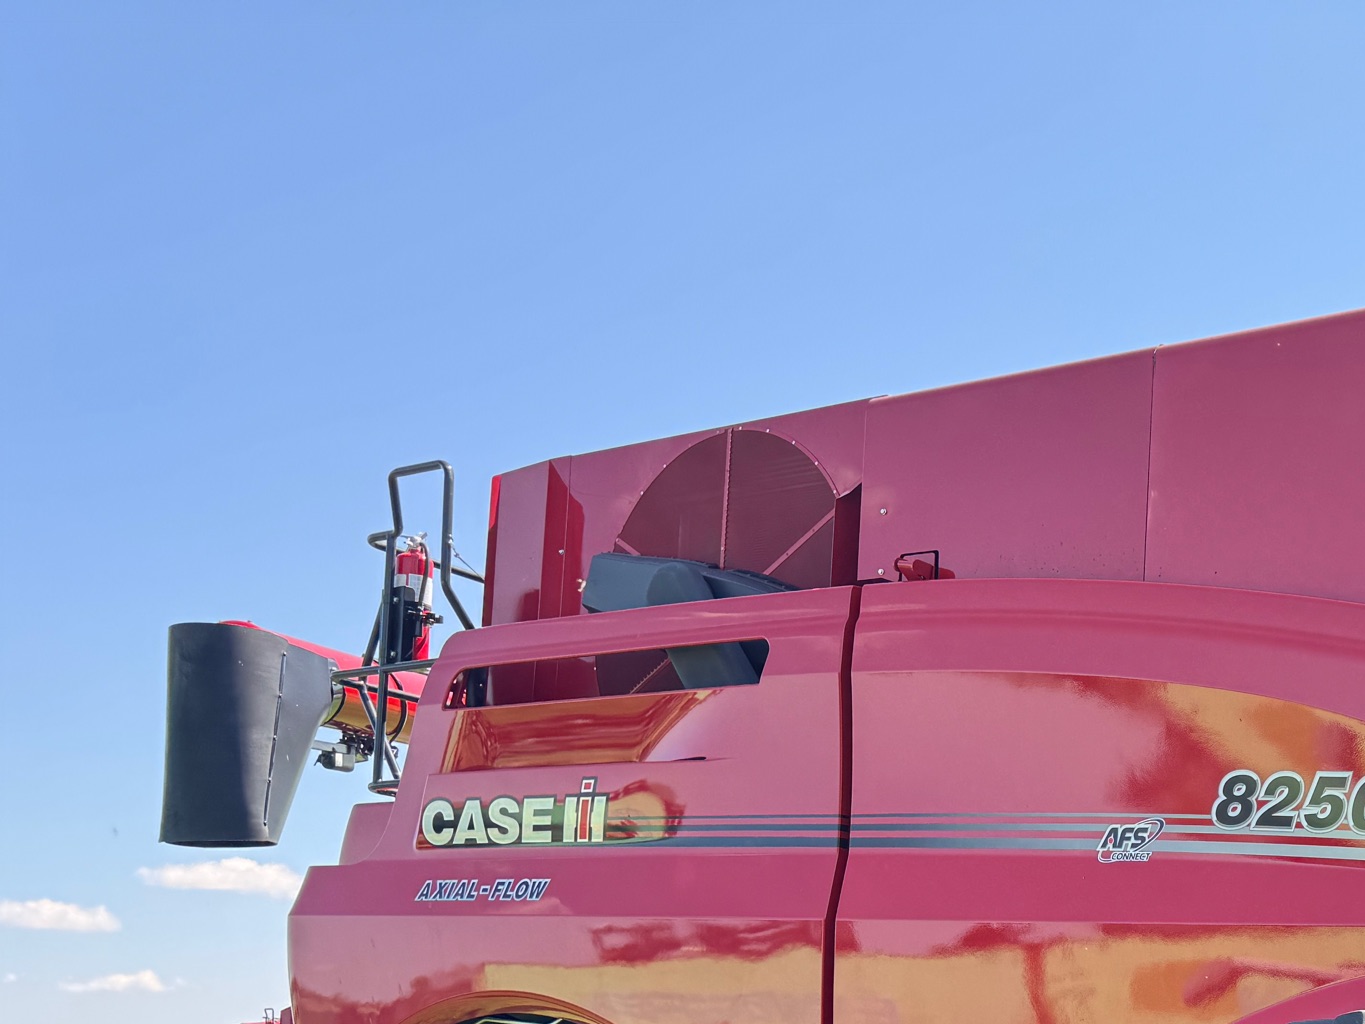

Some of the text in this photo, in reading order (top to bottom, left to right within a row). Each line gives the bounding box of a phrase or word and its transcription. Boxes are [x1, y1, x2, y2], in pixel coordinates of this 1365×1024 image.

[421, 796, 556, 846] CASE
[1096, 824, 1151, 851] AFS
[1111, 851, 1152, 861] CONNECT
[415, 878, 551, 901] AXIAL-FLOW
